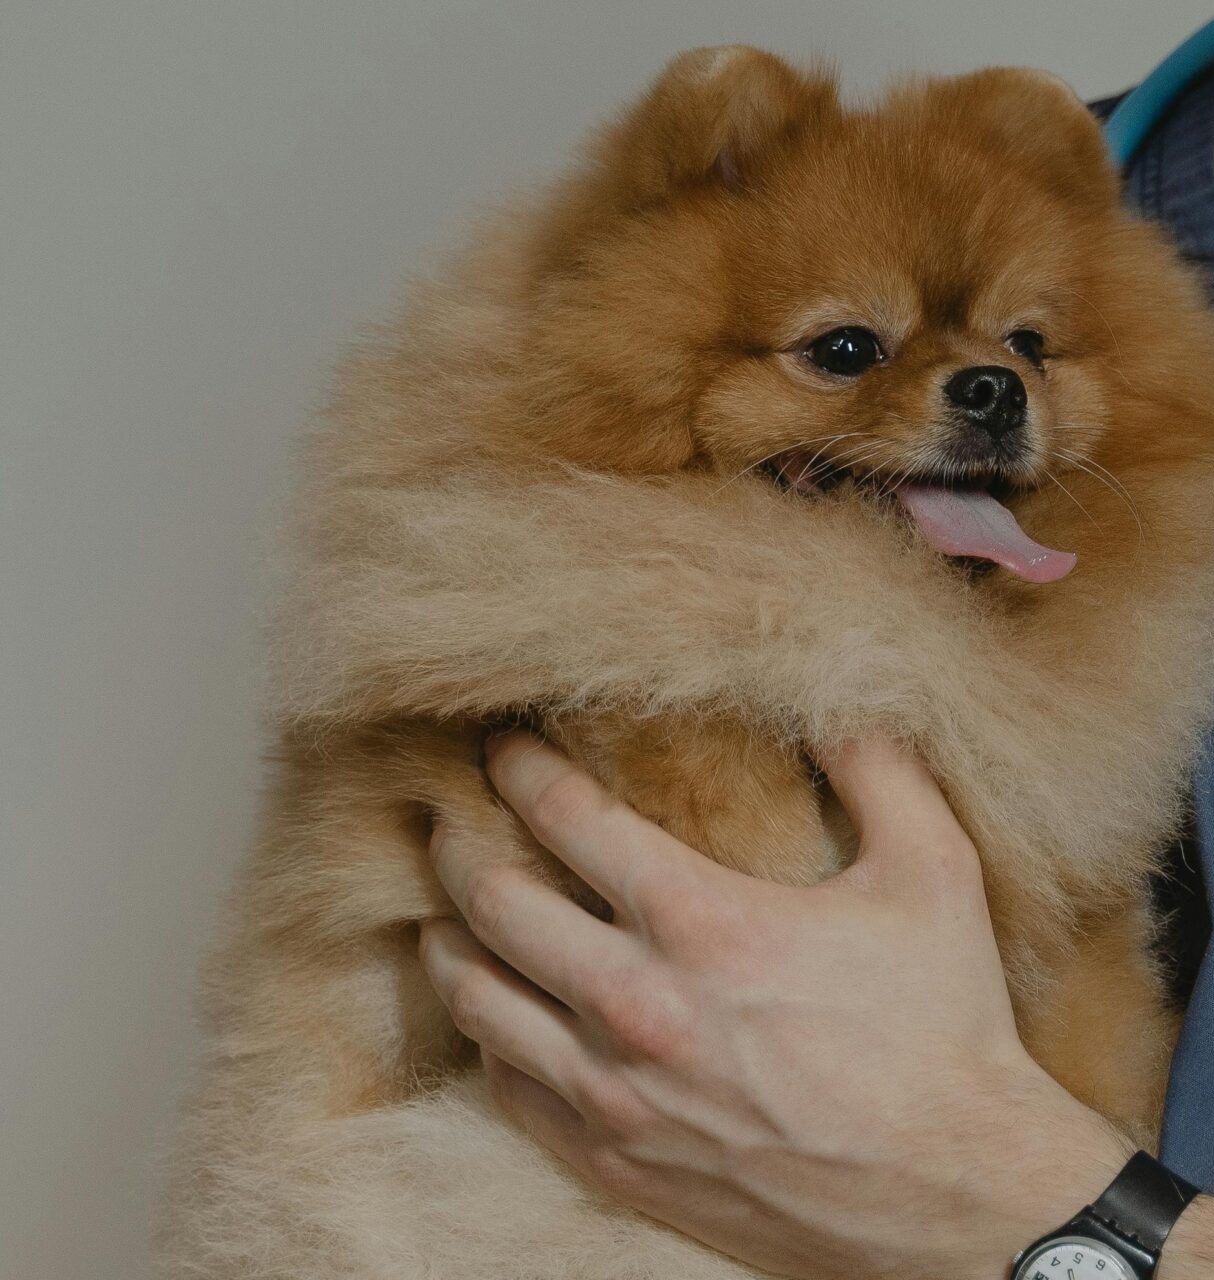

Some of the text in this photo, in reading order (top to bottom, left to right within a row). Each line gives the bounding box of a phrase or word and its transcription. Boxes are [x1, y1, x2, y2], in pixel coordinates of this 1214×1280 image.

[1051, 1256, 1061, 1267] 4
[1072, 1252, 1084, 1264] 5
[1096, 1259, 1106, 1271] 6
